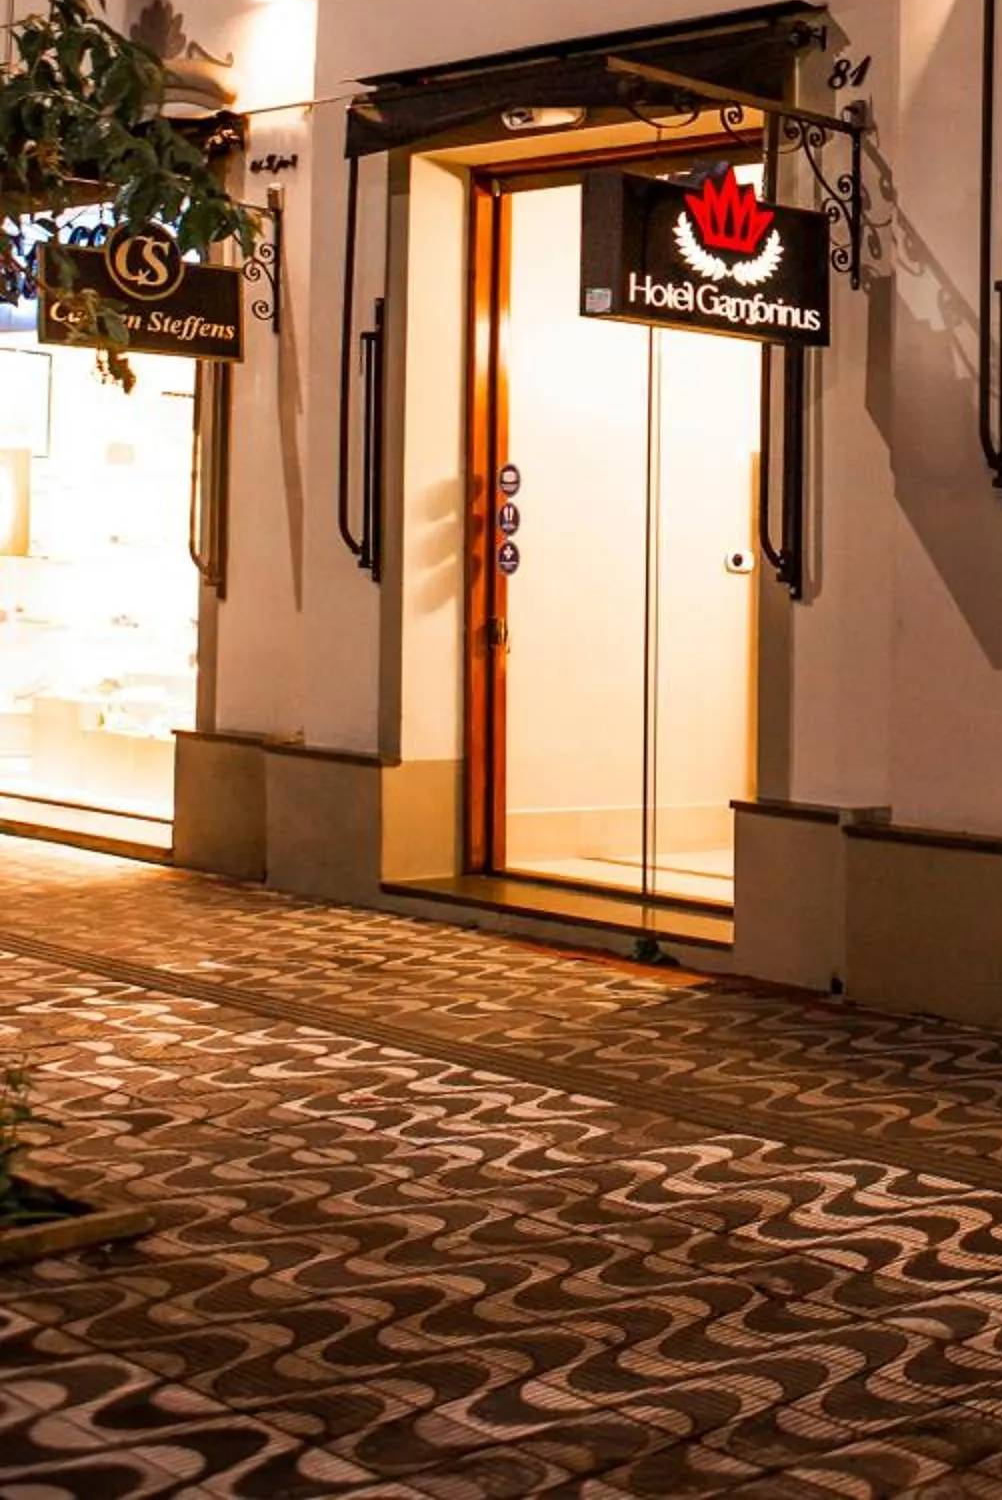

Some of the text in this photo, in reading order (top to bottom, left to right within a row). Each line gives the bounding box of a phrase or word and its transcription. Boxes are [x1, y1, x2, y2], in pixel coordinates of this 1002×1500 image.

[629, 272, 821, 331] Hotel Gambrinus
[147, 311, 236, 341] Steffens
